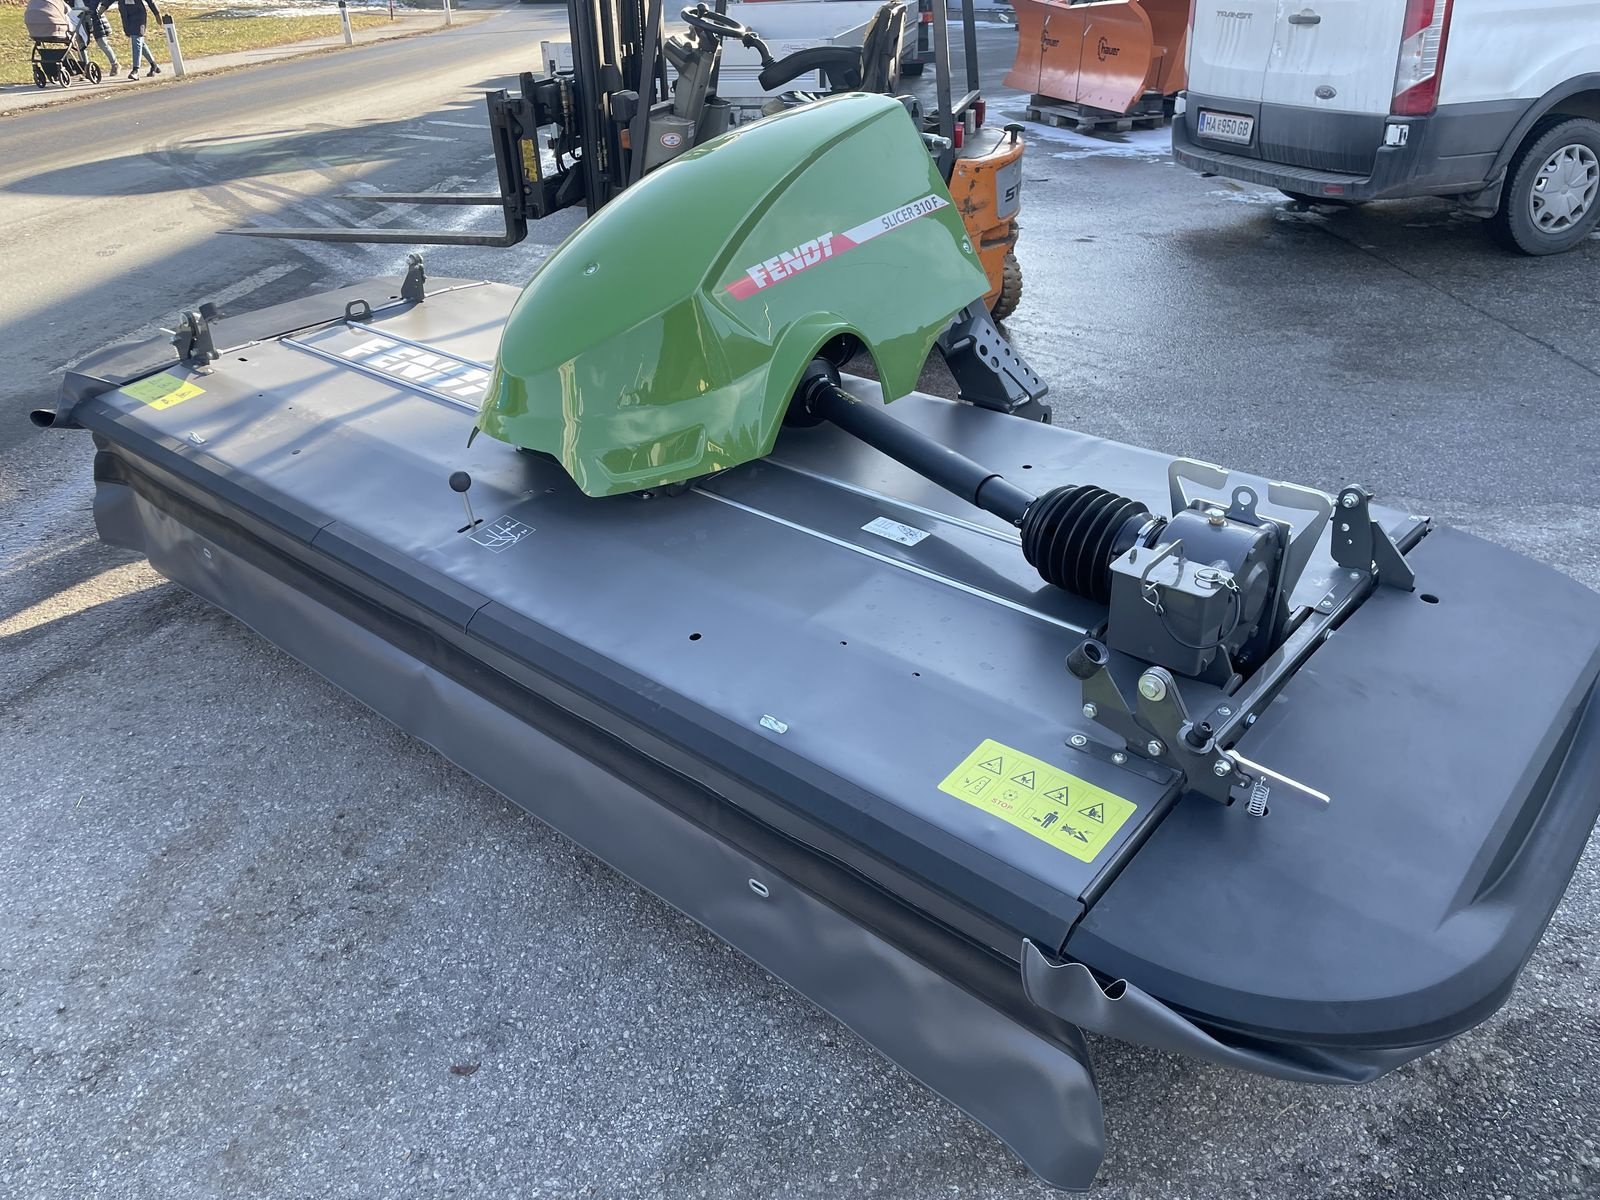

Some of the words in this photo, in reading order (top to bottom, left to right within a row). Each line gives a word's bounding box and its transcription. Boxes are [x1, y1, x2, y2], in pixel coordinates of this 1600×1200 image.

[1216, 10, 1253, 19] TRANSIT
[1205, 116, 1216, 132] HA
[1221, 119, 1237, 135] 950
[1237, 120, 1249, 136] GB
[881, 206, 915, 230] SLICER
[914, 199, 932, 215] 310
[931, 196, 938, 209] F
[745, 231, 833, 288] FENDT
[991, 798, 1013, 810] STOP
